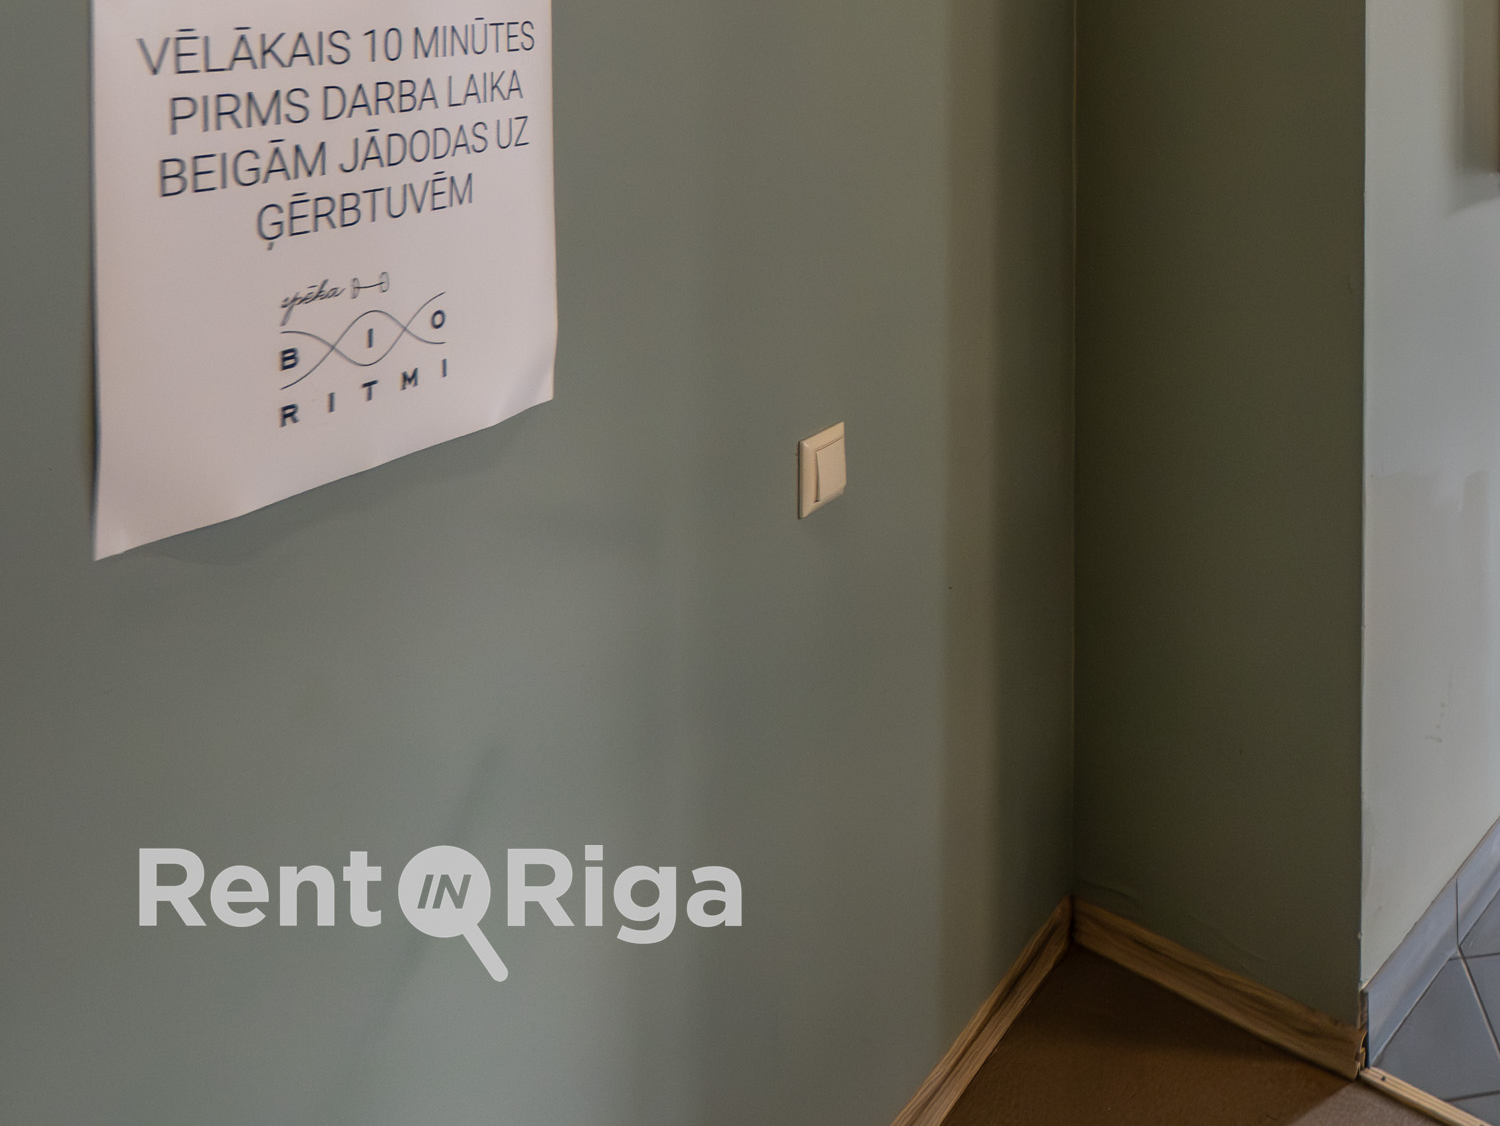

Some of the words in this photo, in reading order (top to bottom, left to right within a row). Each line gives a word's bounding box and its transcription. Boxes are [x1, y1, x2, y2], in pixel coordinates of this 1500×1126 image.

[136, 26, 351, 75] VĒLĀKAIS
[363, 27, 402, 62] 10
[413, 17, 536, 60] MINŪTES
[169, 87, 310, 135] PIRMS
[323, 77, 439, 122] DARBA
[447, 69, 523, 107] LAIKA
[159, 139, 327, 198] BEIGĀM
[338, 122, 488, 174] JĀDODAS
[496, 115, 530, 149] UZ
[257, 171, 474, 251] ĢĒRBTUVĒM
[279, 358, 448, 428] RITMI
